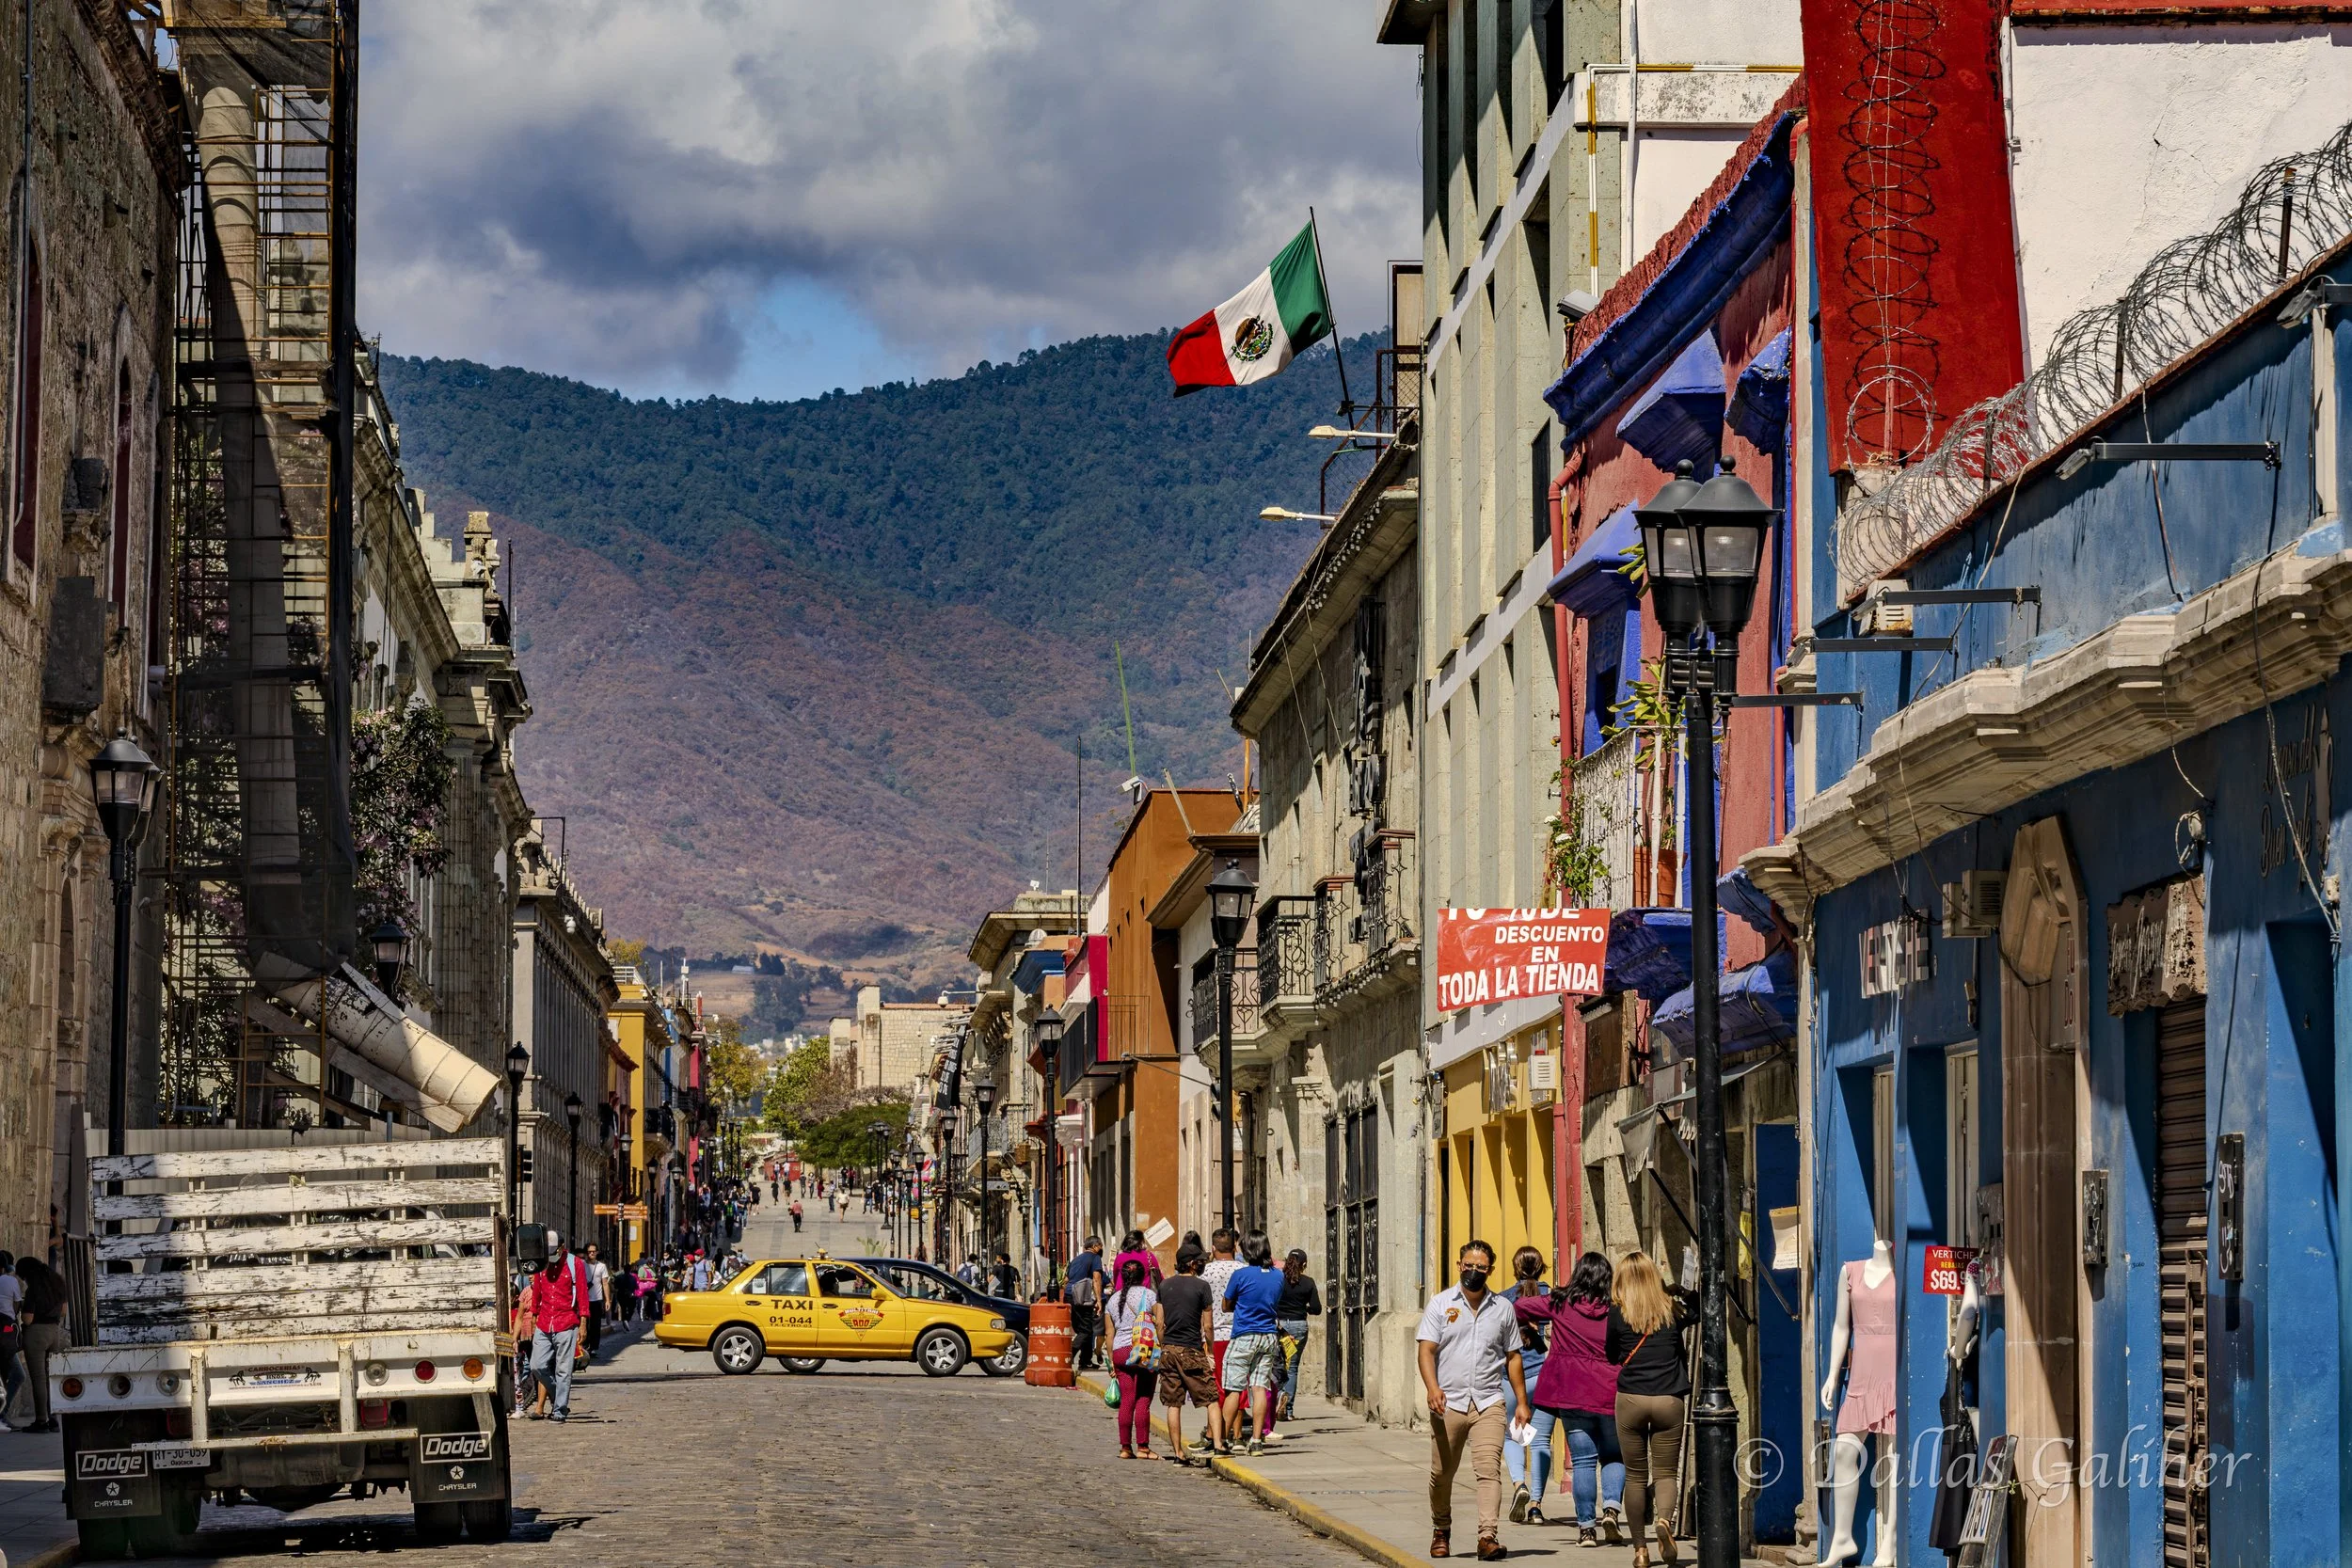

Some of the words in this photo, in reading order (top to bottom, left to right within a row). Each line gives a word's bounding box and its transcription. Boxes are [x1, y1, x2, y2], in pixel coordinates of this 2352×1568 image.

[1494, 926, 1605, 944] DESCUENTO
[1531, 946, 1559, 962] EN
[1438, 969, 1489, 1007] TODA
[1495, 966, 1519, 998] LA
[1525, 962, 1599, 994] TIENDA
[1931, 1249, 1976, 1259] VERTICHE
[771, 1299, 814, 1310] TAXI
[425, 1436, 486, 1457] Dodge
[81, 1453, 142, 1474] Dodge
[438, 1482, 477, 1491] CHRYSLER
[94, 1499, 133, 1508] CHRYSLER
